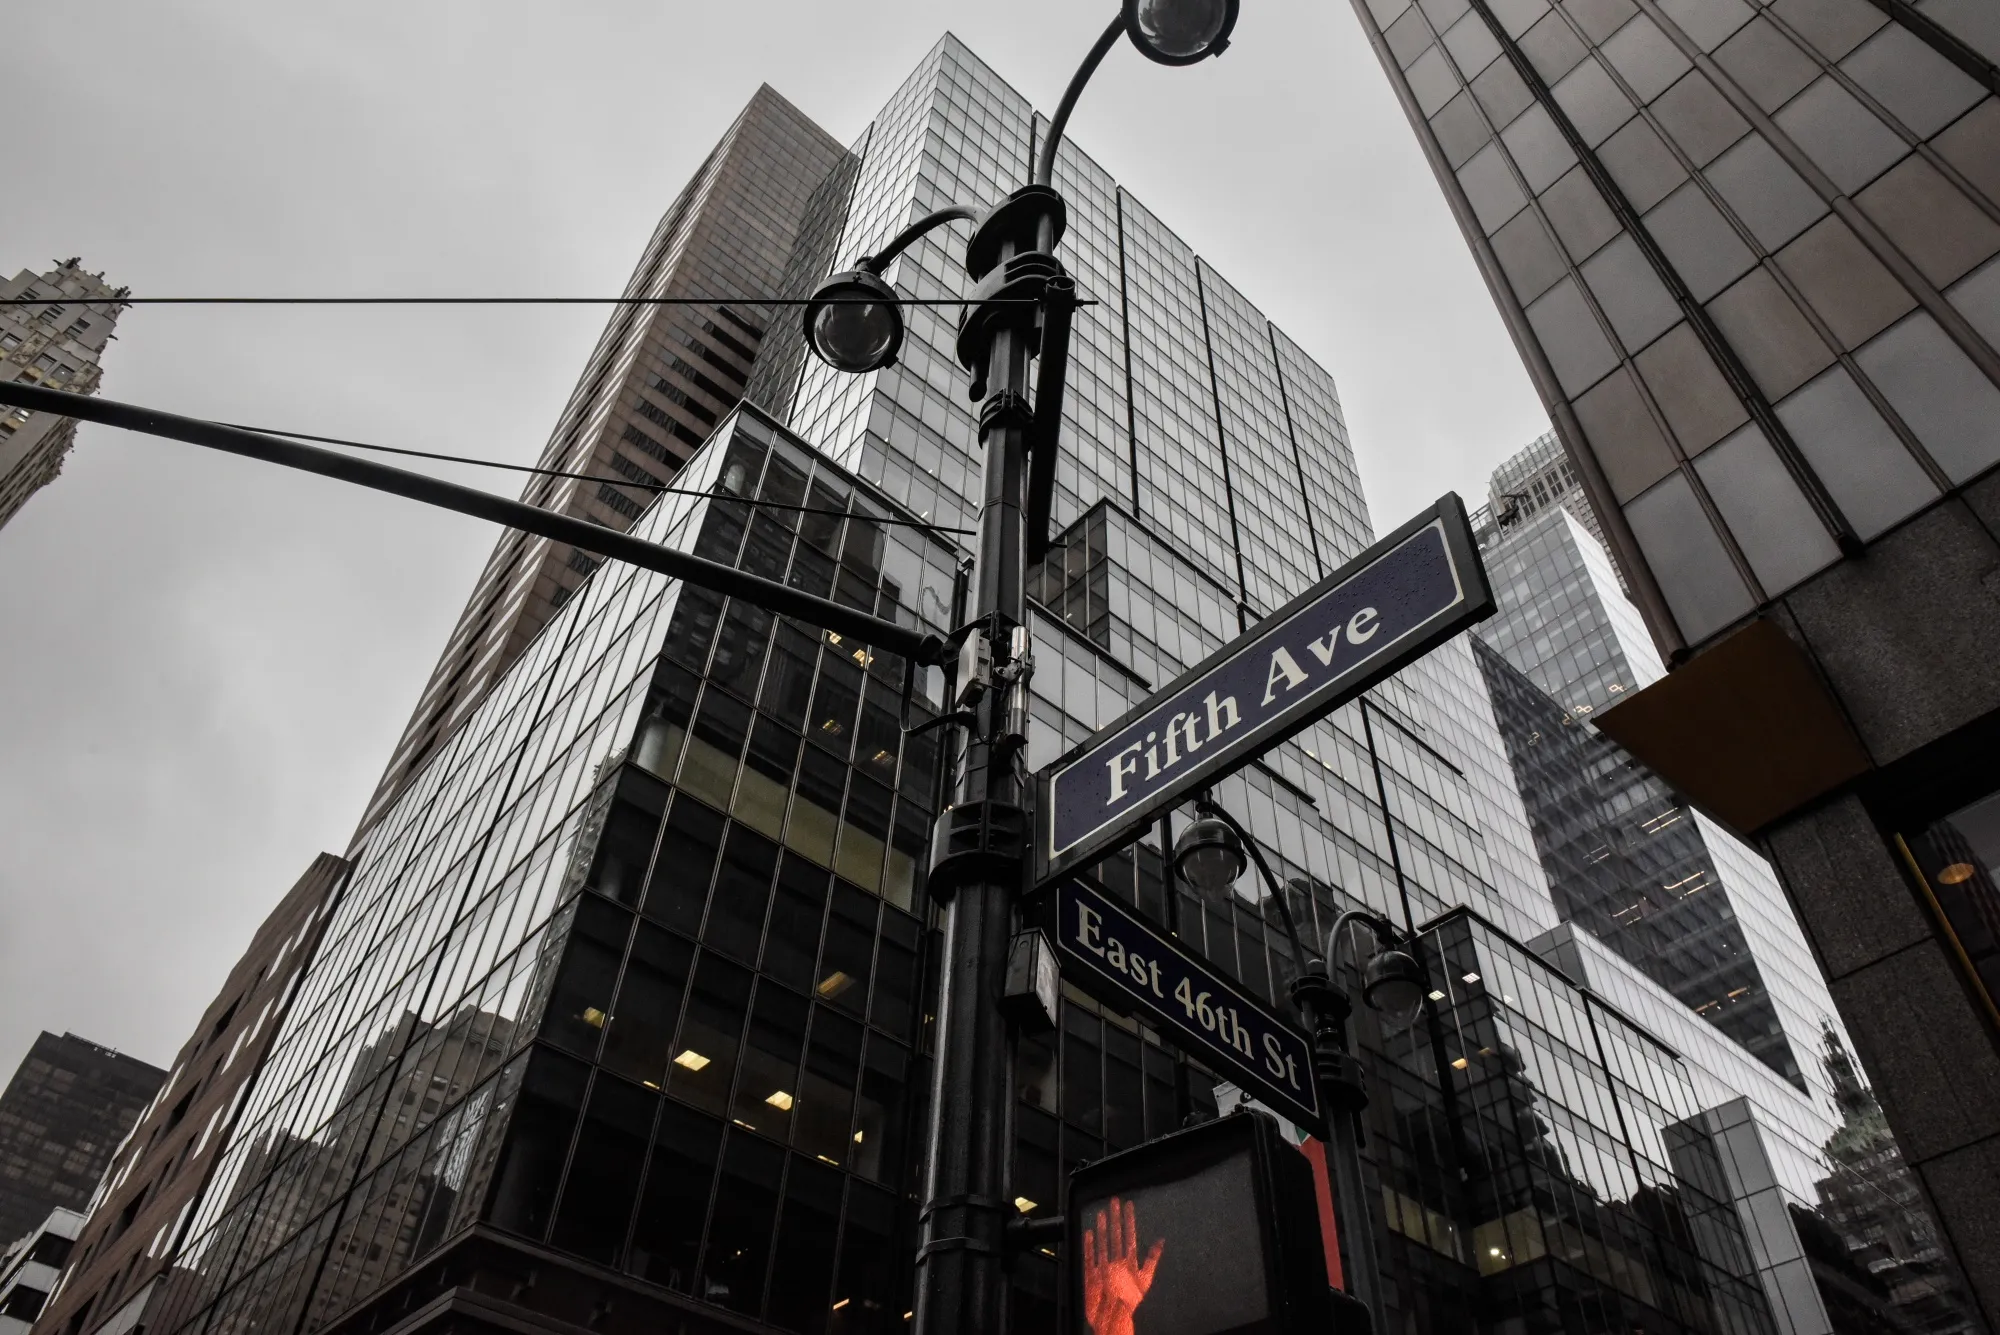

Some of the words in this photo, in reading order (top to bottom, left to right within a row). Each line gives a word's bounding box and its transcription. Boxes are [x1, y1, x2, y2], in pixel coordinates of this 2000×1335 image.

[1104, 690, 1241, 806] Fifth
[1260, 605, 1381, 708] Ave
[1075, 897, 1164, 999] East
[1174, 976, 1255, 1060] 46th
[1262, 1033, 1301, 1091] St
